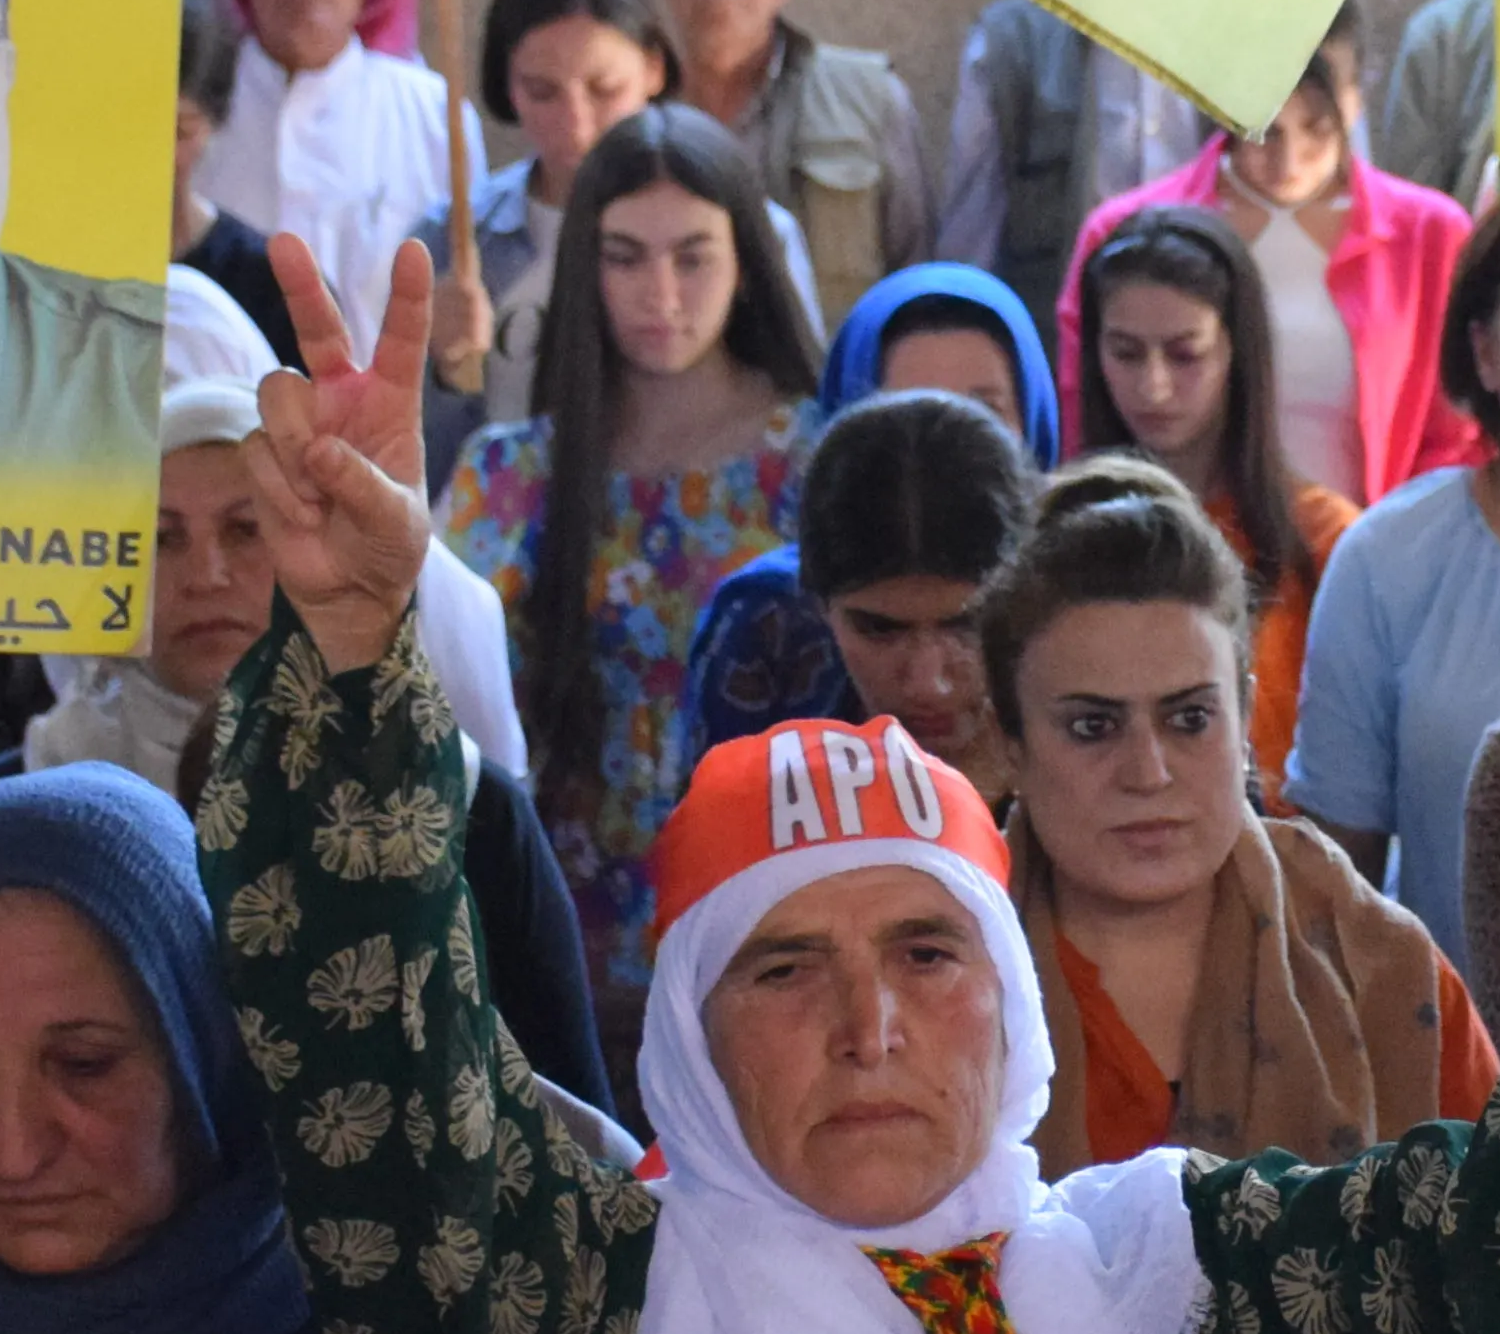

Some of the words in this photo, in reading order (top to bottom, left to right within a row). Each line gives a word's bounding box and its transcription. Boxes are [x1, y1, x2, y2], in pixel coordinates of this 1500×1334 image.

[0, 525, 142, 568] NABE
[99, 583, 134, 631] لا
[768, 724, 944, 850] APO
